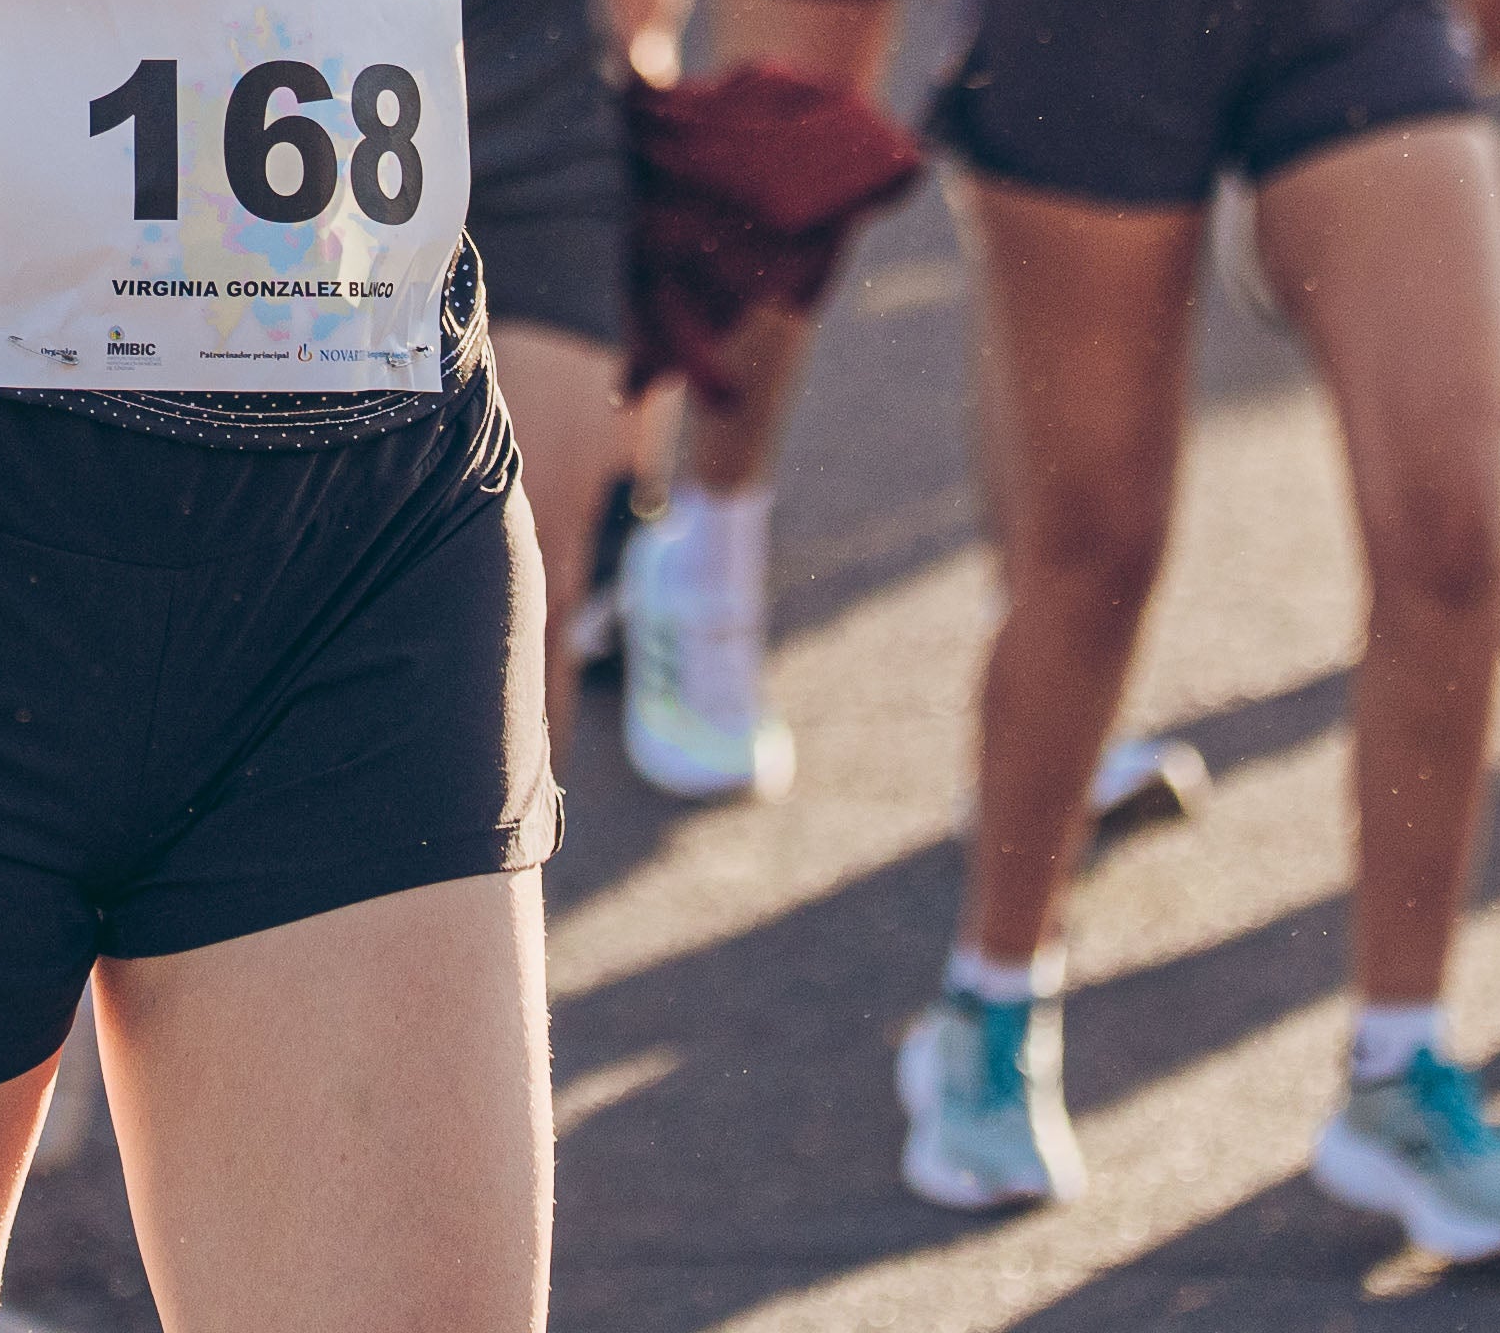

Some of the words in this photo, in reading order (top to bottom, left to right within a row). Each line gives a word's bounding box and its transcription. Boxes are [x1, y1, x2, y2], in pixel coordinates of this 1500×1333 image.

[89, 59, 423, 225] 168
[111, 279, 219, 298] VIRGINIA
[226, 280, 343, 298] GONZALEZ
[107, 342, 156, 356] IMIBIC
[200, 350, 252, 360] Patrocinador
[253, 350, 290, 361] principal
